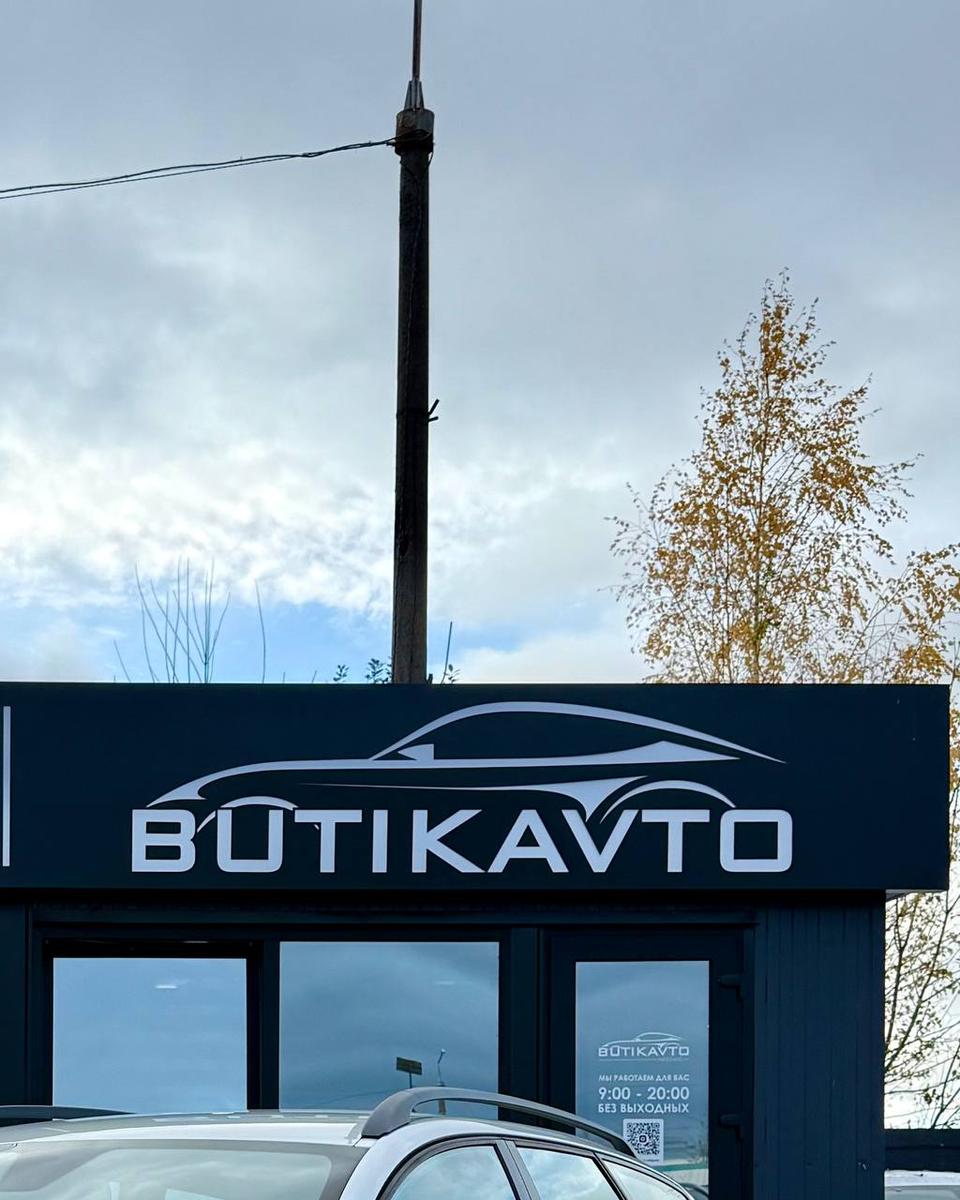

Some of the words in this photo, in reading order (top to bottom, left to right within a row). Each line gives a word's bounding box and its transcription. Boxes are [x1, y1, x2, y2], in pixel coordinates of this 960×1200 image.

[131, 808, 793, 874] BUTIKAVTO
[598, 1045, 690, 1057] BUTIKAVTO
[599, 1073, 613, 1081] МЫ
[614, 1073, 654, 1081] РАБОТАЕМ
[673, 1073, 690, 1081] ВАС
[598, 1086, 631, 1100] 9:00
[647, 1086, 690, 1100] 20:00
[598, 1103, 617, 1113] БЕЗ
[620, 1103, 689, 1114] ВЫХОДНЫХ
